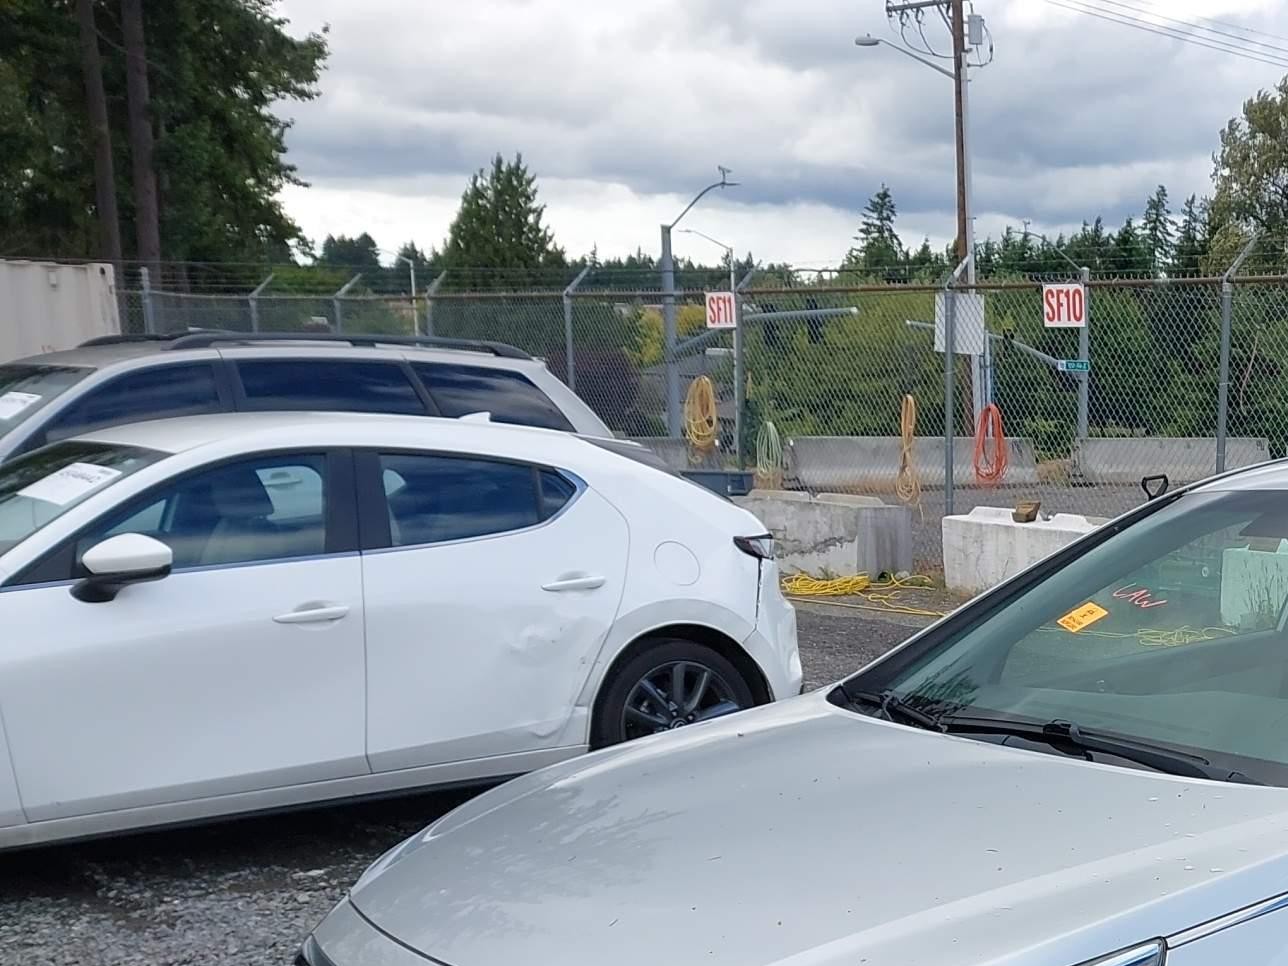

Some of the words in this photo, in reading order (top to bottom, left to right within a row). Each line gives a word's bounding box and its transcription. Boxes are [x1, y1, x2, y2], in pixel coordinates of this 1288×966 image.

[708, 295, 734, 324] SF11
[1045, 288, 1083, 323] SF10
[1112, 582, 1168, 608] LAW
